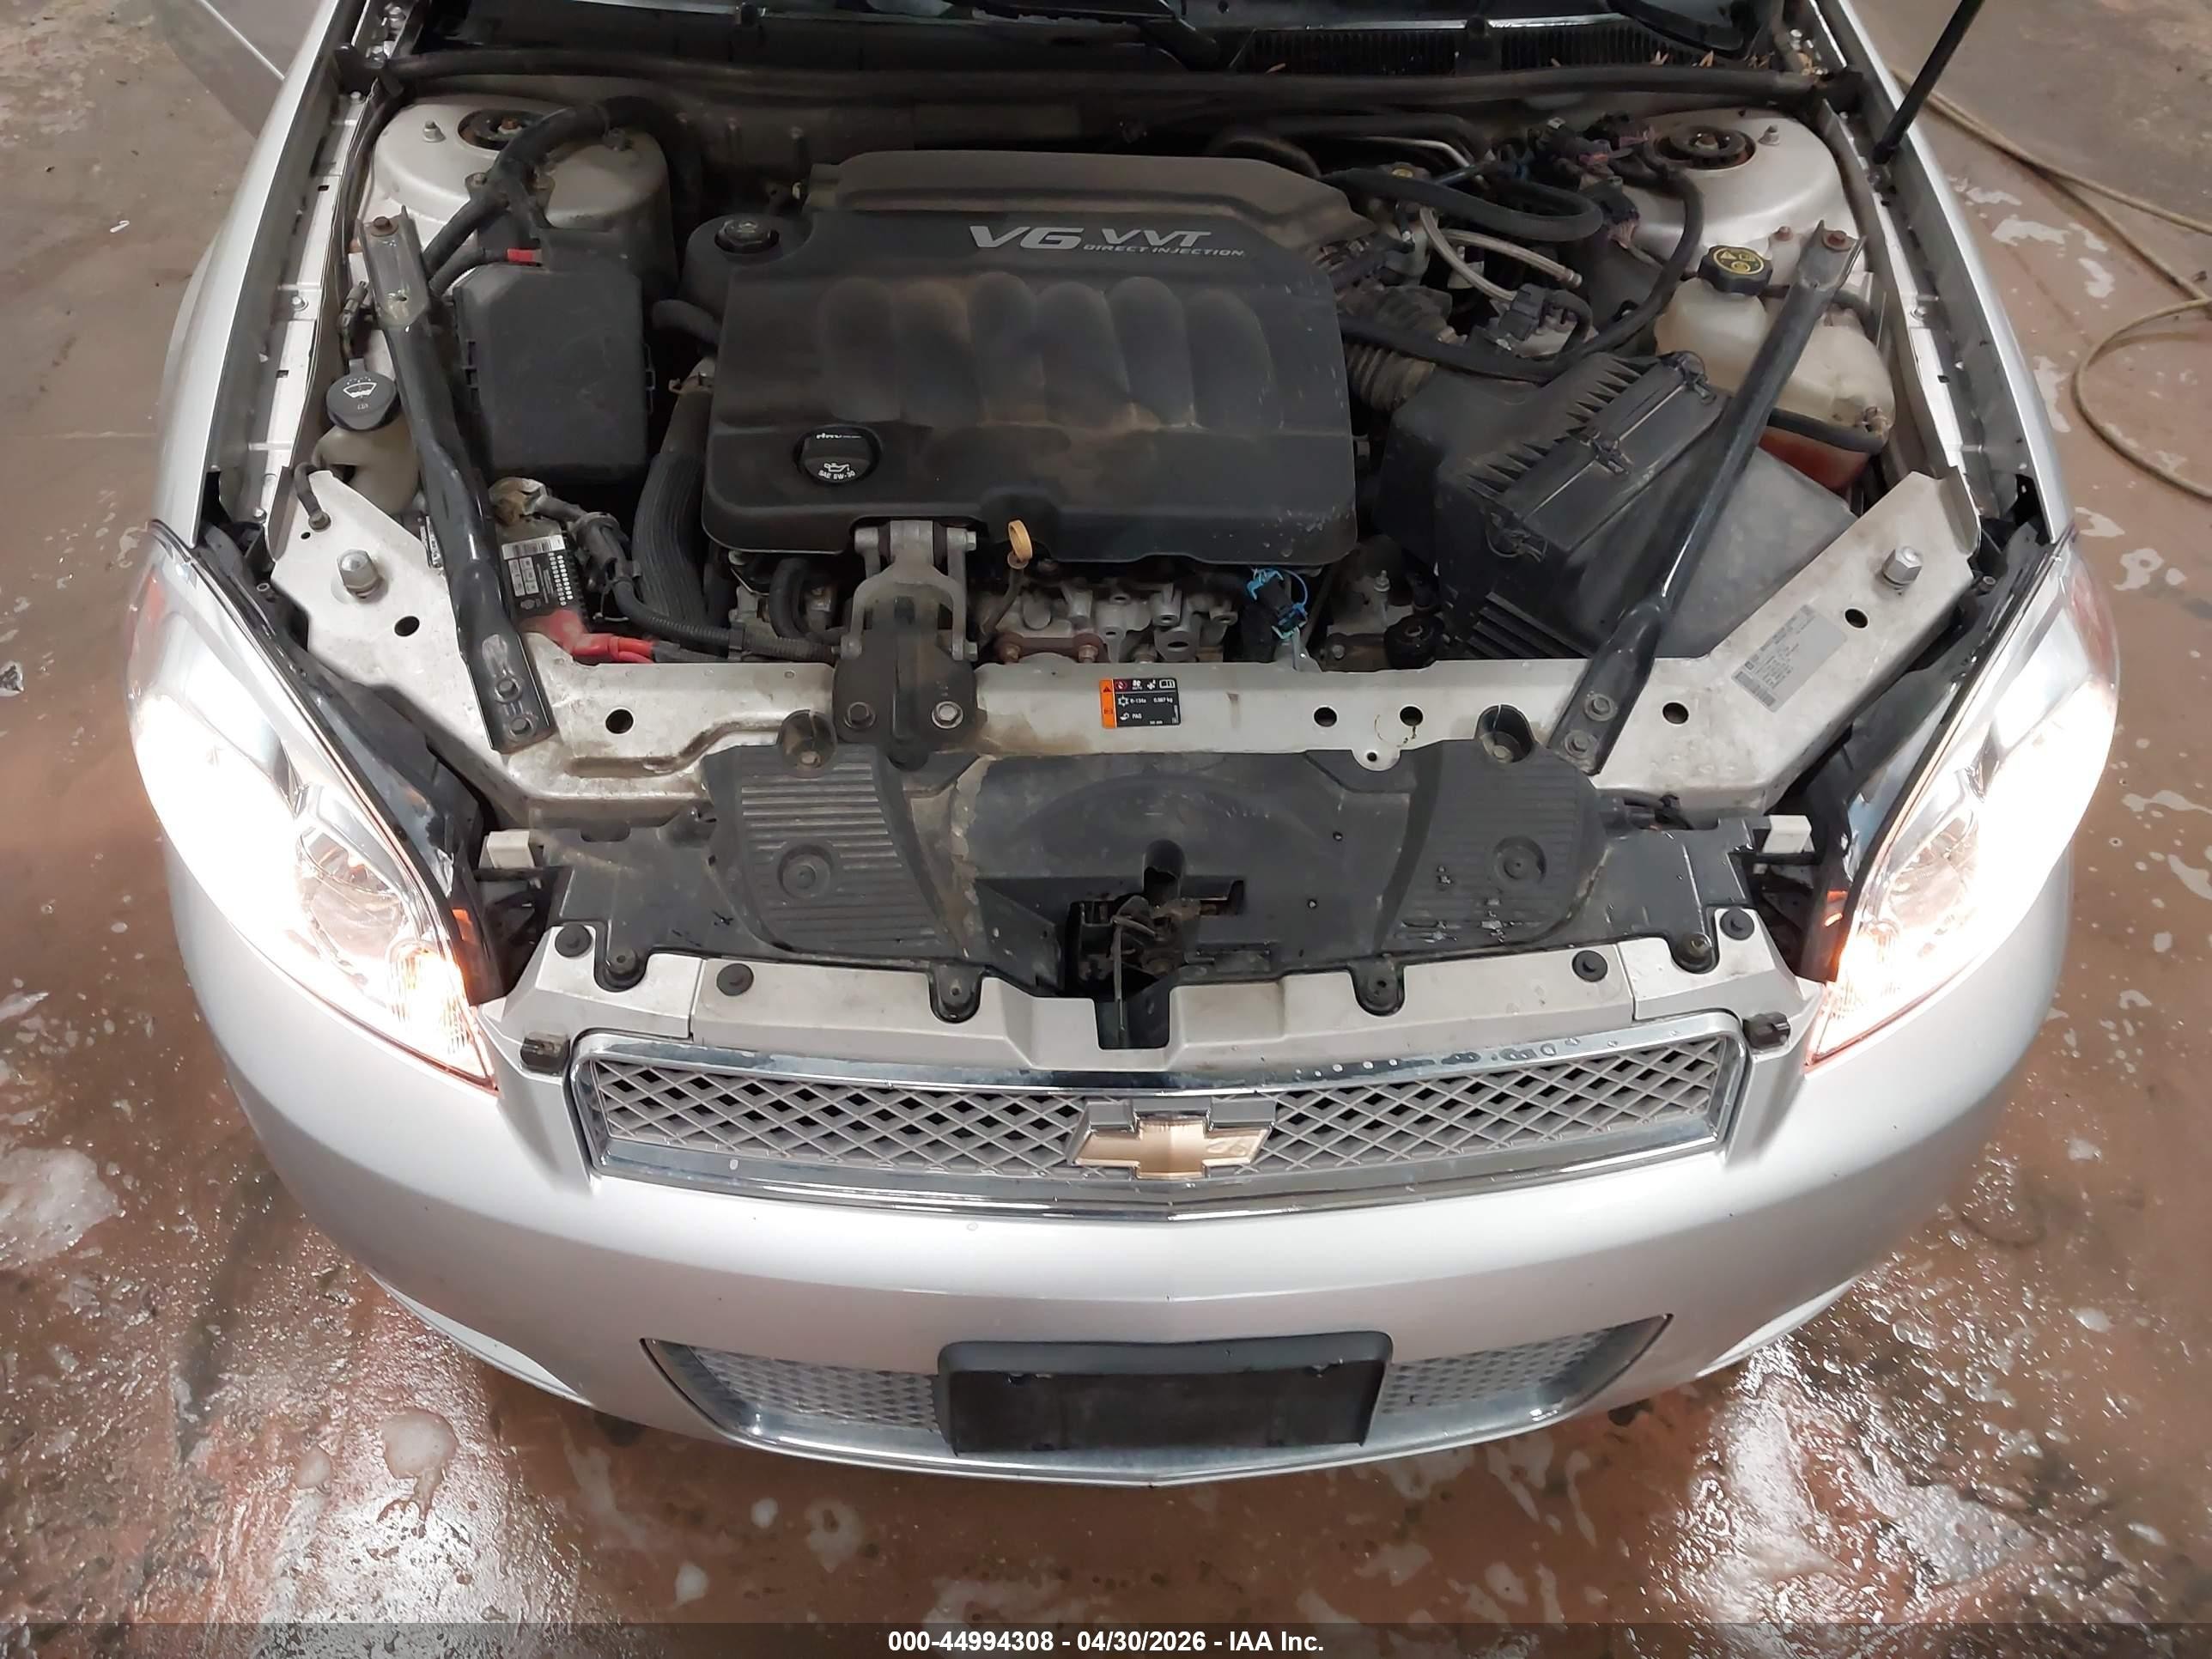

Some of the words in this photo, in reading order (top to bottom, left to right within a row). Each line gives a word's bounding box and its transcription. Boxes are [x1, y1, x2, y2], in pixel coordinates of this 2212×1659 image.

[969, 226, 1085, 249] V6
[1102, 228, 1212, 247] VVT
[1084, 244, 1149, 252] DIRECT
[1152, 246, 1244, 257] INJECTION
